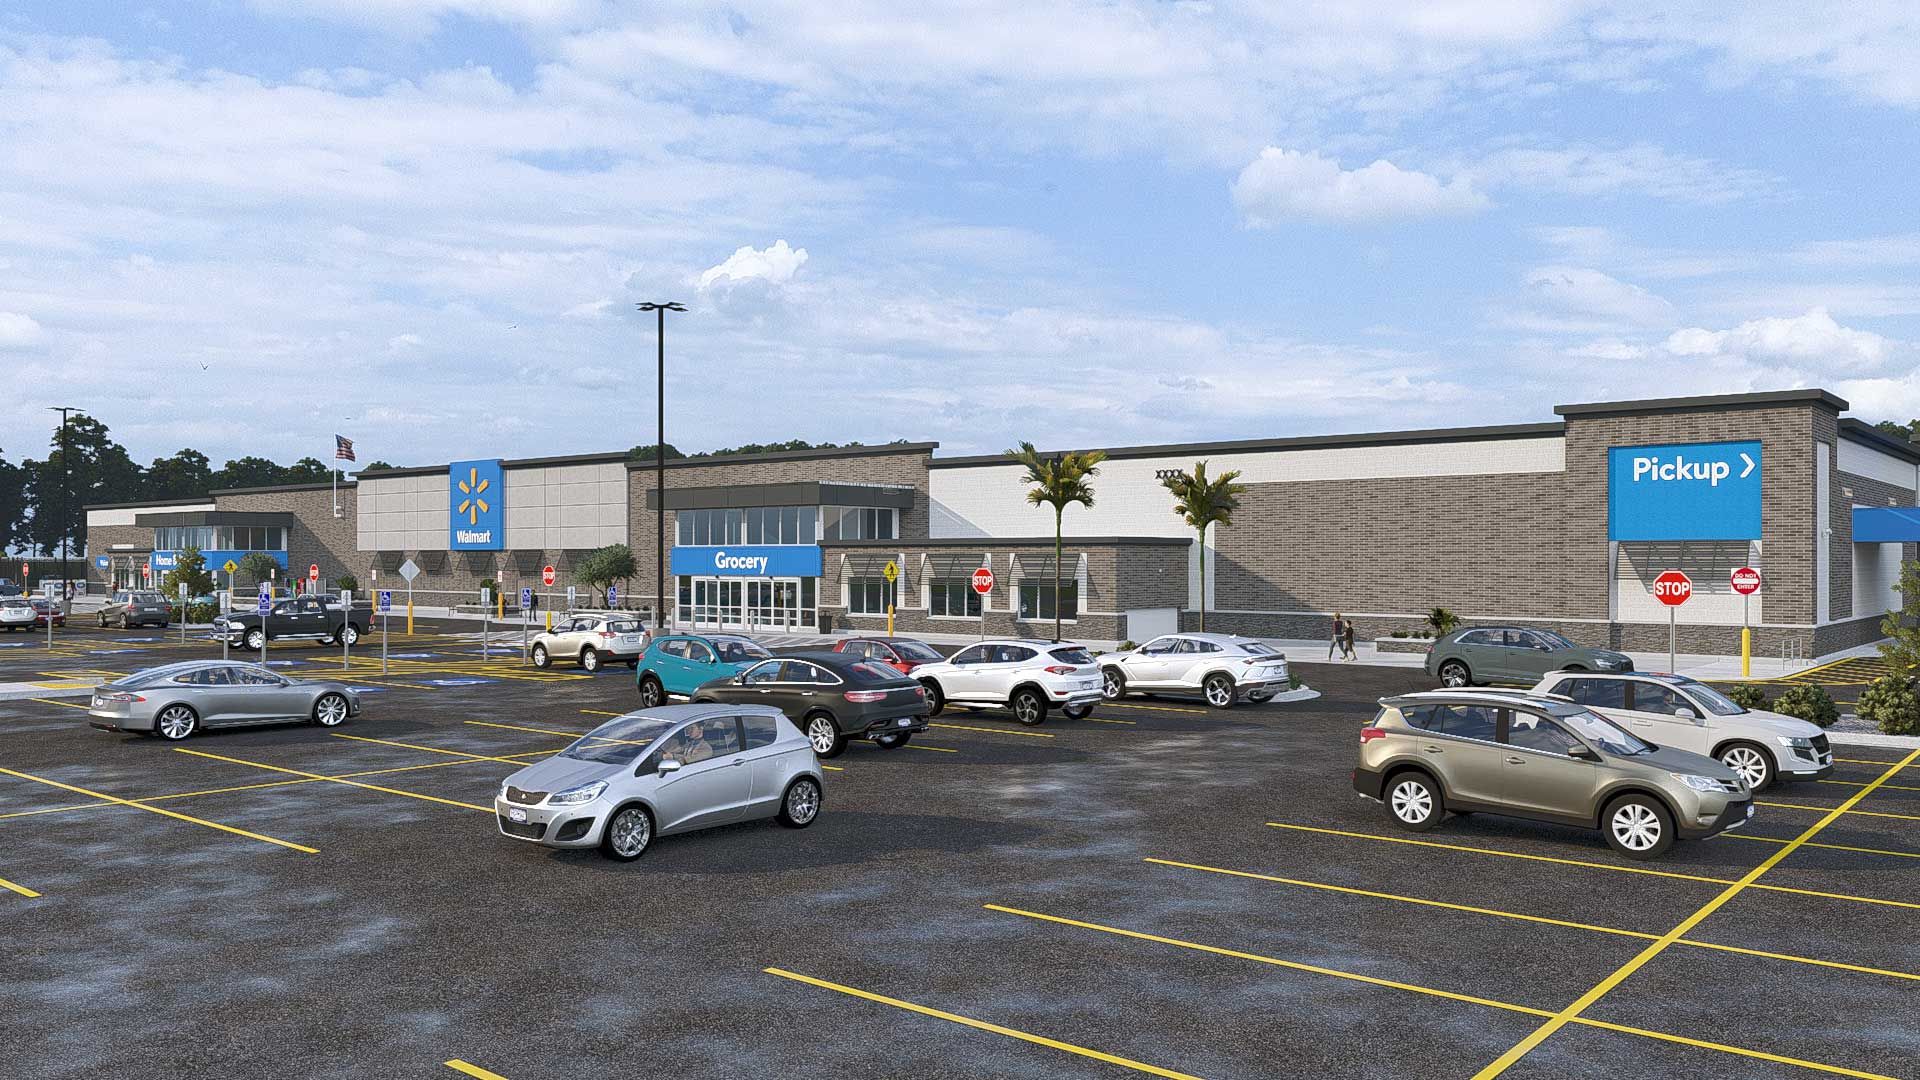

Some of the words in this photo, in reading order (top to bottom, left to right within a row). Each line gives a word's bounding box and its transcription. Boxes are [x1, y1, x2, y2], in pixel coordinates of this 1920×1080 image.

[1633, 455, 1730, 487] Pickup
[456, 529, 491, 544] Walmart
[155, 554, 172, 566] Home
[714, 551, 769, 575] Grocery
[974, 575, 992, 586] STOP
[1655, 581, 1690, 596] STOP
